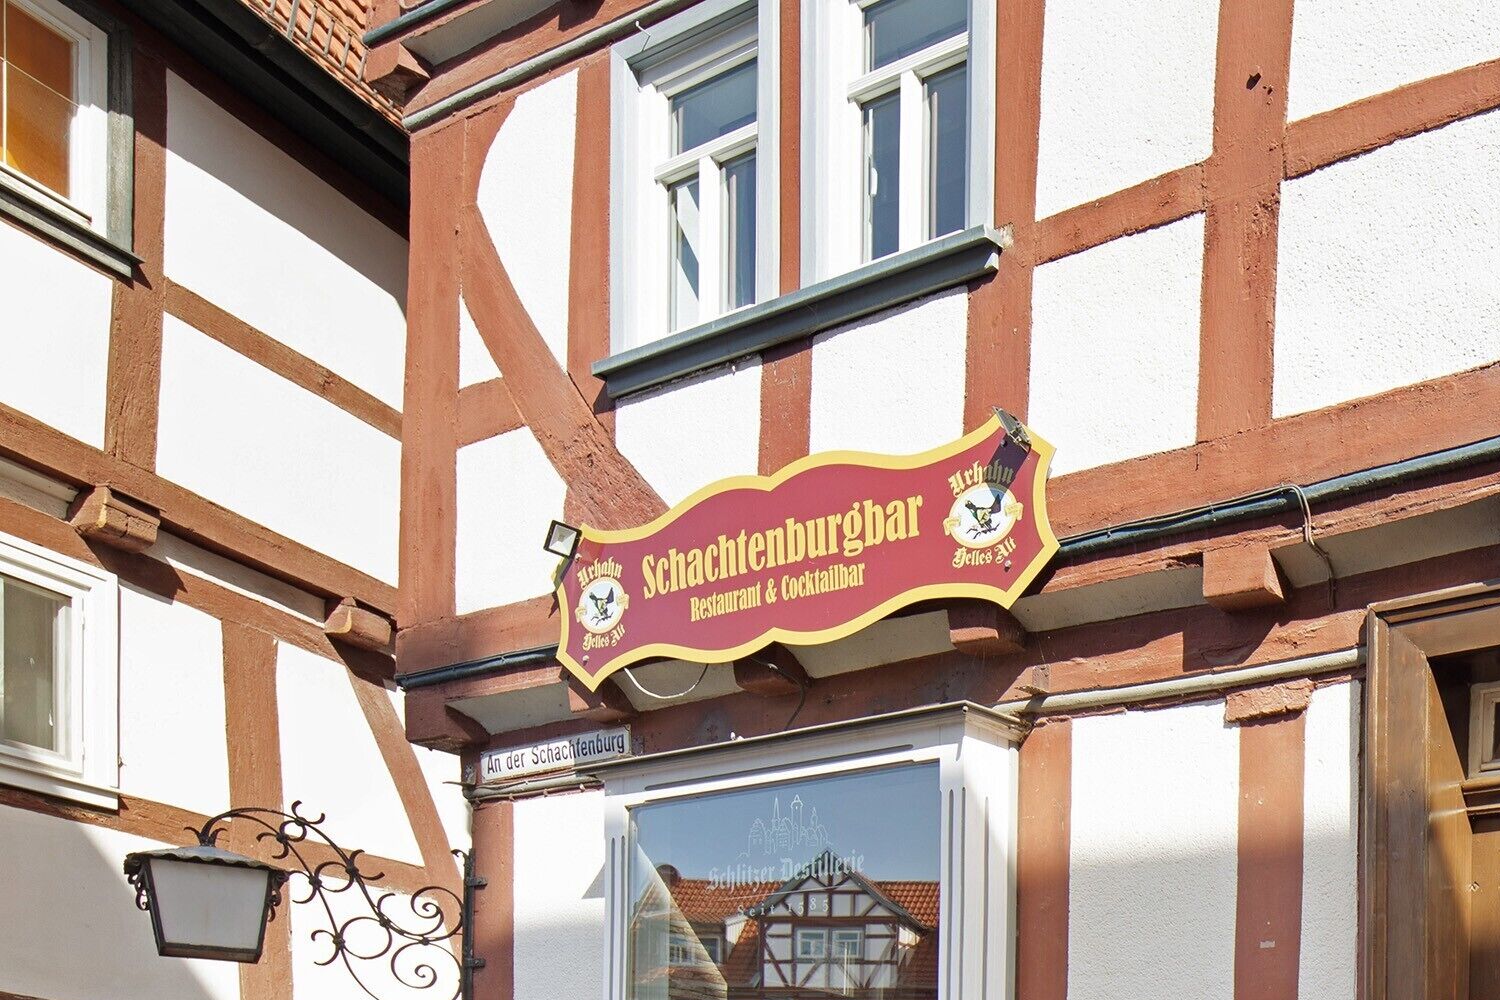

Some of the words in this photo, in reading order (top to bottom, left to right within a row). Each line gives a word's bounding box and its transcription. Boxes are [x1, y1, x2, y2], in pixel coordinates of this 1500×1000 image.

[641, 494, 924, 600] Schachtenburgbar
[952, 546, 993, 569] Helles
[994, 536, 1017, 564] Alt
[690, 581, 762, 622] Restaurant
[765, 578, 778, 604] &
[781, 562, 866, 600] Cocktailbar
[487, 755, 501, 775] An
[506, 751, 526, 770] der
[531, 733, 626, 765] Schachtenburg
[705, 864, 776, 895] Schlitzer
[780, 850, 866, 881] Destillerie
[737, 903, 775, 918] Seit
[787, 898, 829, 915] 1585
